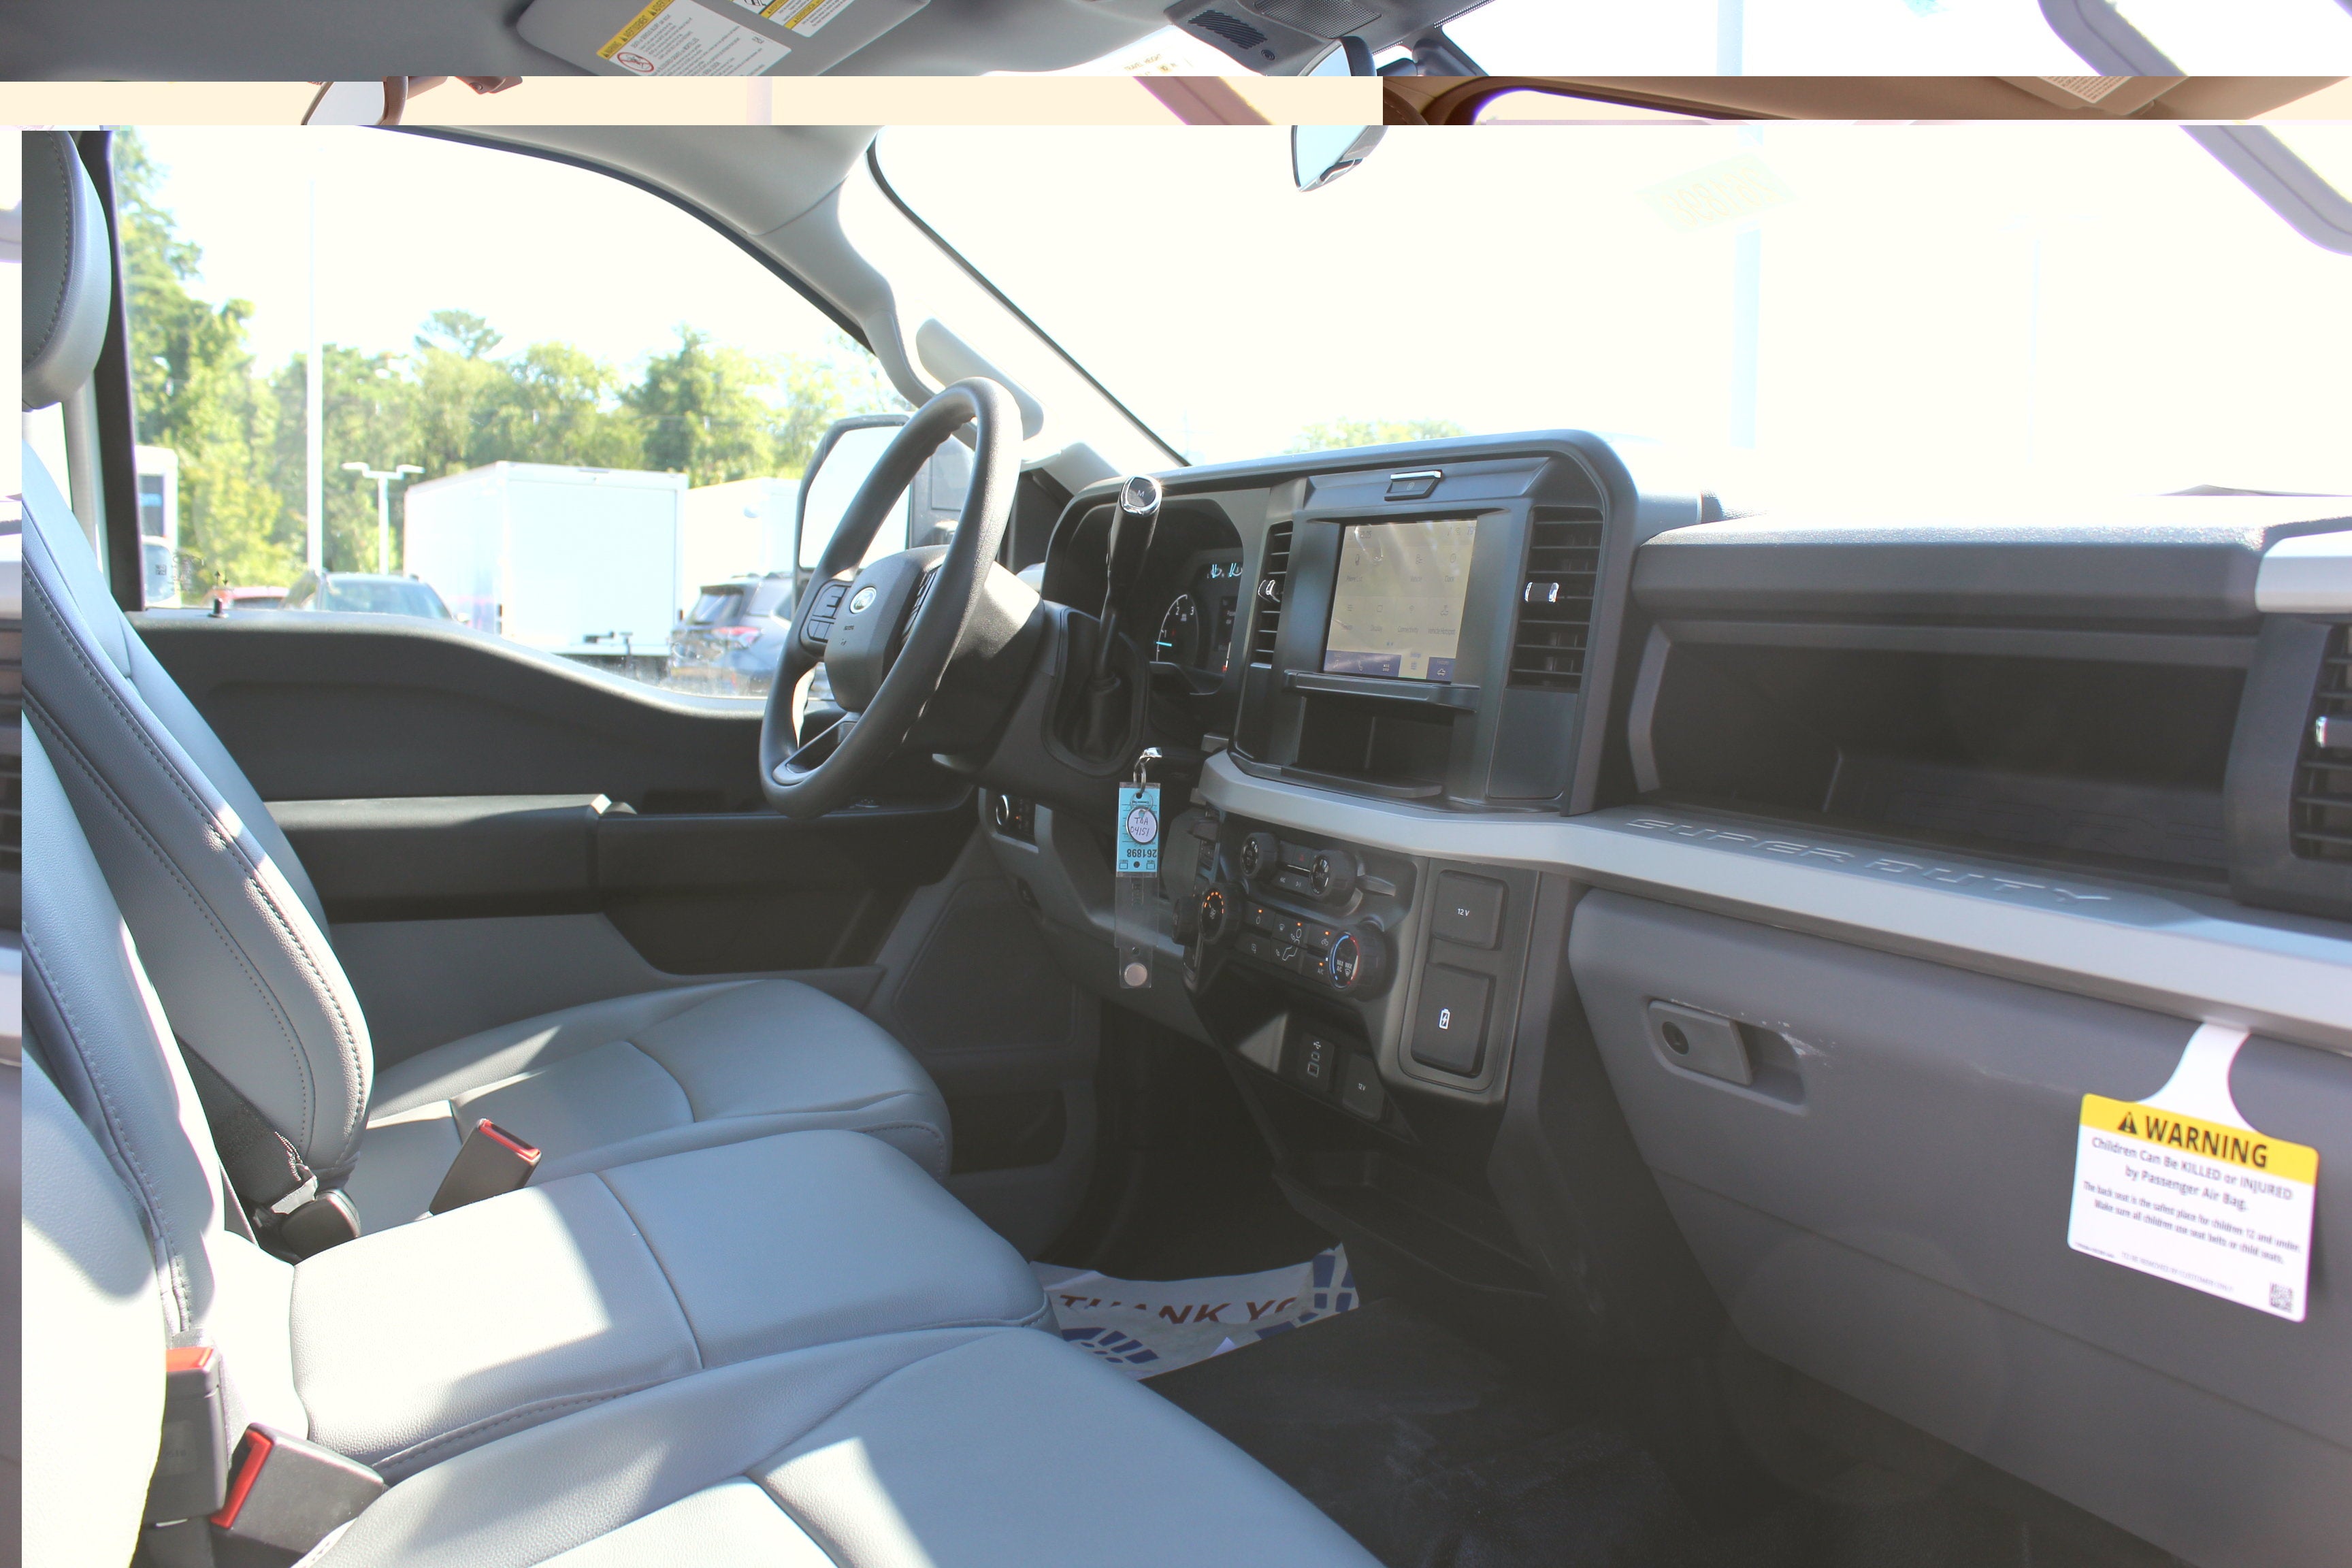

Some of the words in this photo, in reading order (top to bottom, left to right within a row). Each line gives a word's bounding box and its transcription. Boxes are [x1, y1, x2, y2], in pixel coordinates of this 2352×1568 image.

[1127, 848, 1158, 858] 261898
[1130, 826, 1150, 836] 04151
[1625, 819, 1855, 864] SUPER
[1864, 858, 2112, 903] DUTY
[2145, 1115, 2268, 1169] WARNING
[2091, 1135, 2137, 1159] Children
[2139, 1147, 2161, 1166] Can
[2163, 1154, 2178, 1171] Be
[2180, 1158, 2222, 1182] KILLED
[2223, 1174, 2237, 1186] or
[2239, 1175, 2293, 1204] INJURED
[2125, 1164, 2138, 1181] by
[2140, 1169, 2199, 1199] Passenger
[2202, 1186, 2219, 1202] Air
[2222, 1191, 2249, 1213] Bag.
[1060, 1294, 1231, 1324] TNK
